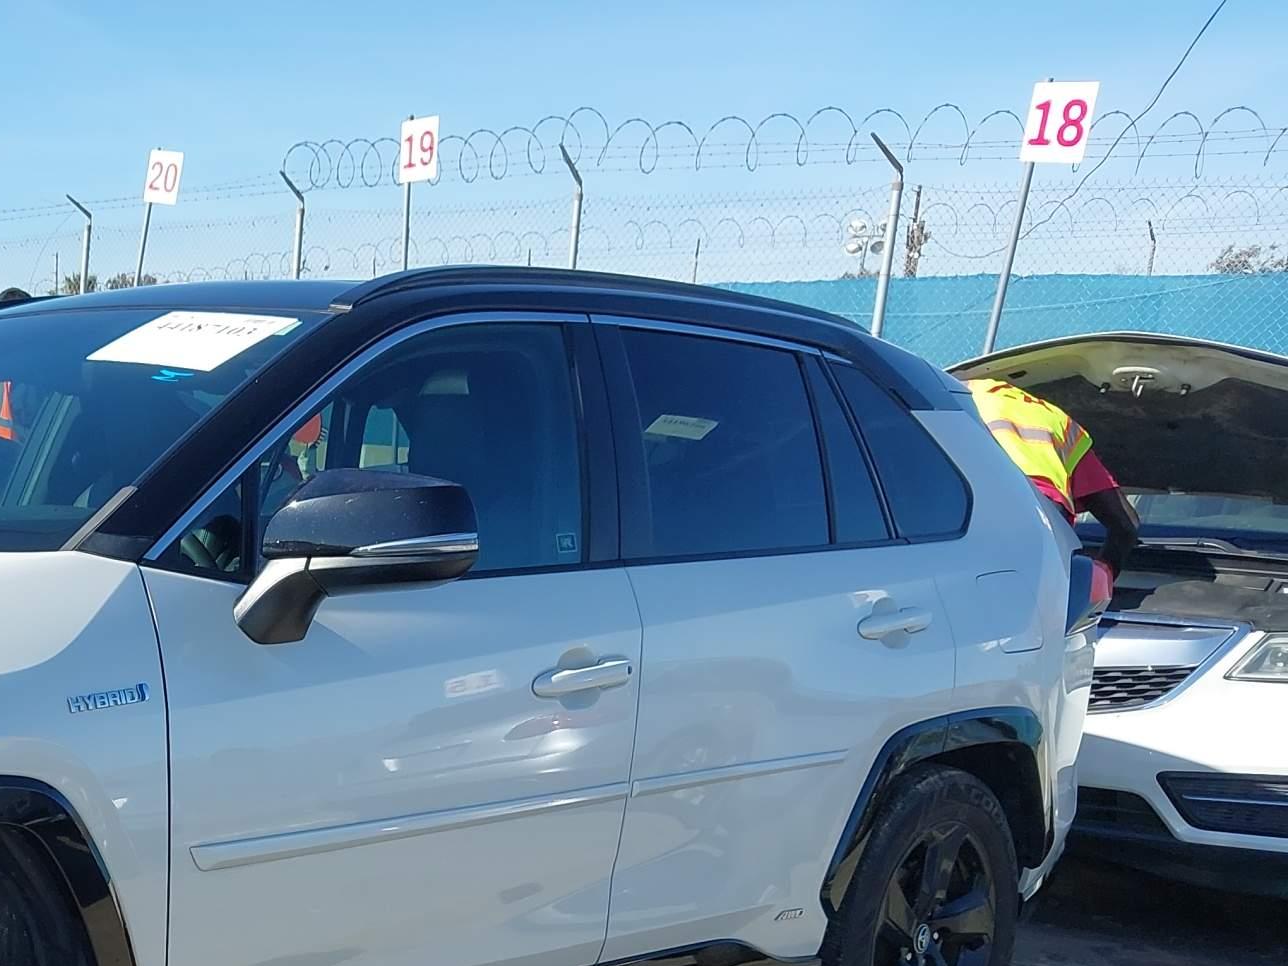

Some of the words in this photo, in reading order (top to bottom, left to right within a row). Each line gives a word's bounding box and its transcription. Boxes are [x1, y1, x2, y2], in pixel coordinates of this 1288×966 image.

[1027, 99, 1088, 147] 18
[403, 130, 435, 169] 19
[149, 161, 178, 193] 20
[67, 687, 139, 714] HYBRID
